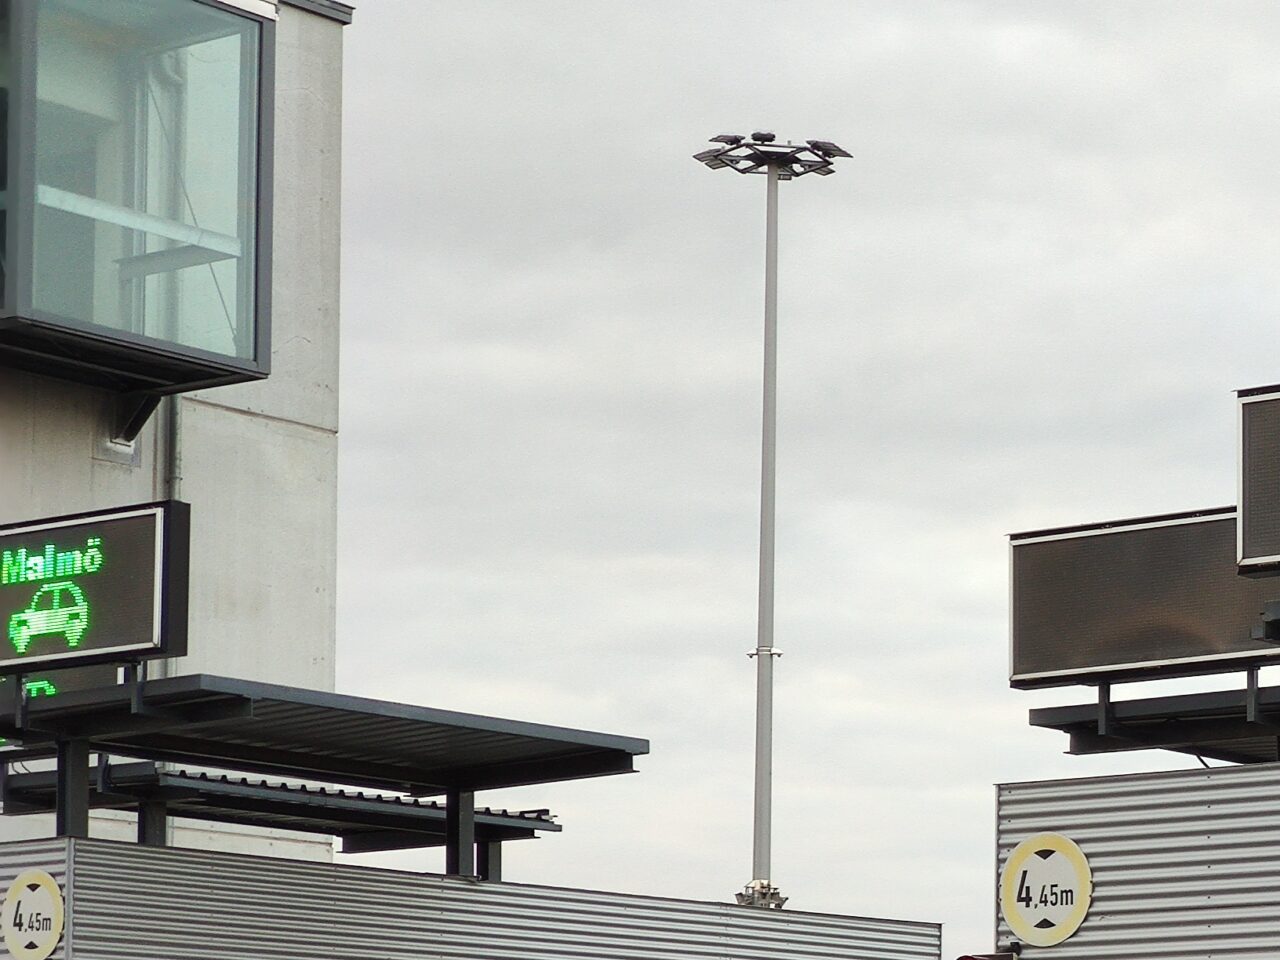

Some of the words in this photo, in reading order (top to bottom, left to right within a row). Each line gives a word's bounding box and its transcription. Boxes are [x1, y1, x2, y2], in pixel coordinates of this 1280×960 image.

[2, 537, 103, 585] Malmö
[1016, 870, 1074, 909] 4,45m
[13, 900, 51, 933] 4,45m
